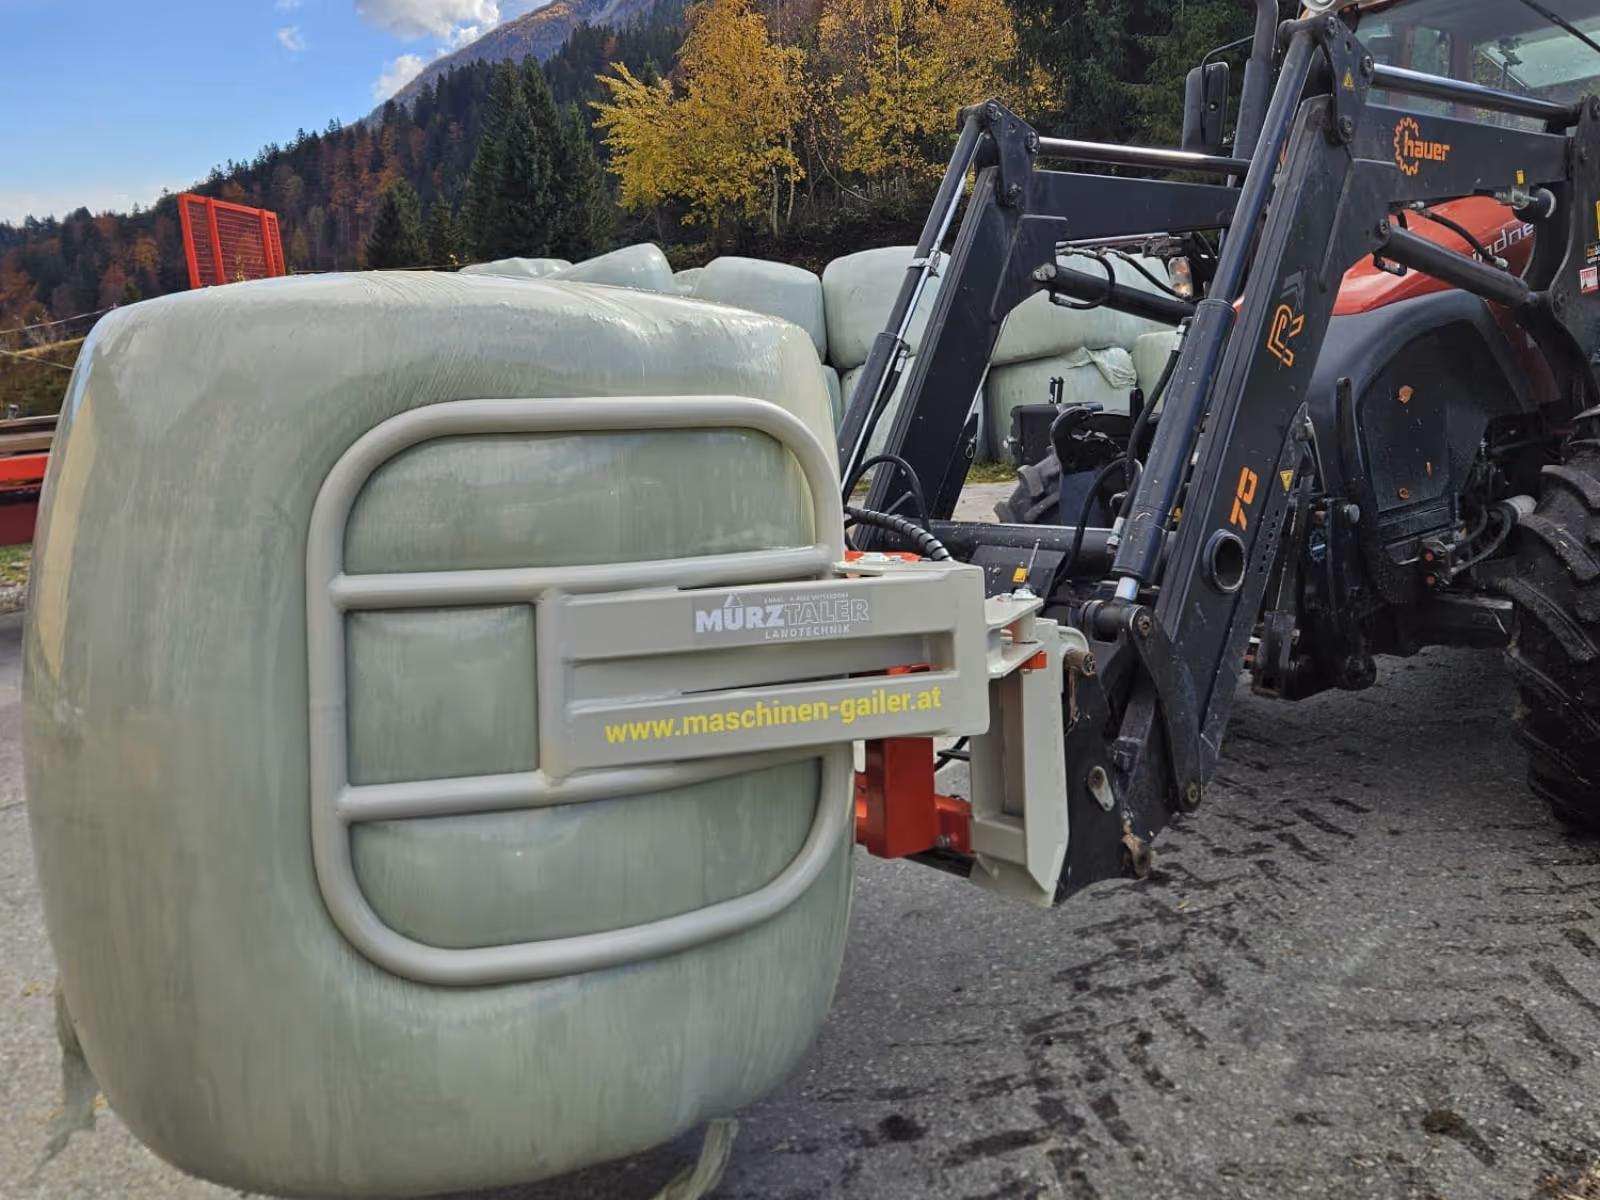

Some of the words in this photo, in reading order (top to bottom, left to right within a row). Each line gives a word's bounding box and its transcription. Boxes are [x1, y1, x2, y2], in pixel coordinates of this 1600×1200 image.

[1403, 129, 1450, 161] hauer
[1229, 466, 1258, 530] 70
[765, 624, 850, 640] LANDTECHNIK
[604, 687, 942, 744] www.maschinen-gailer.at
